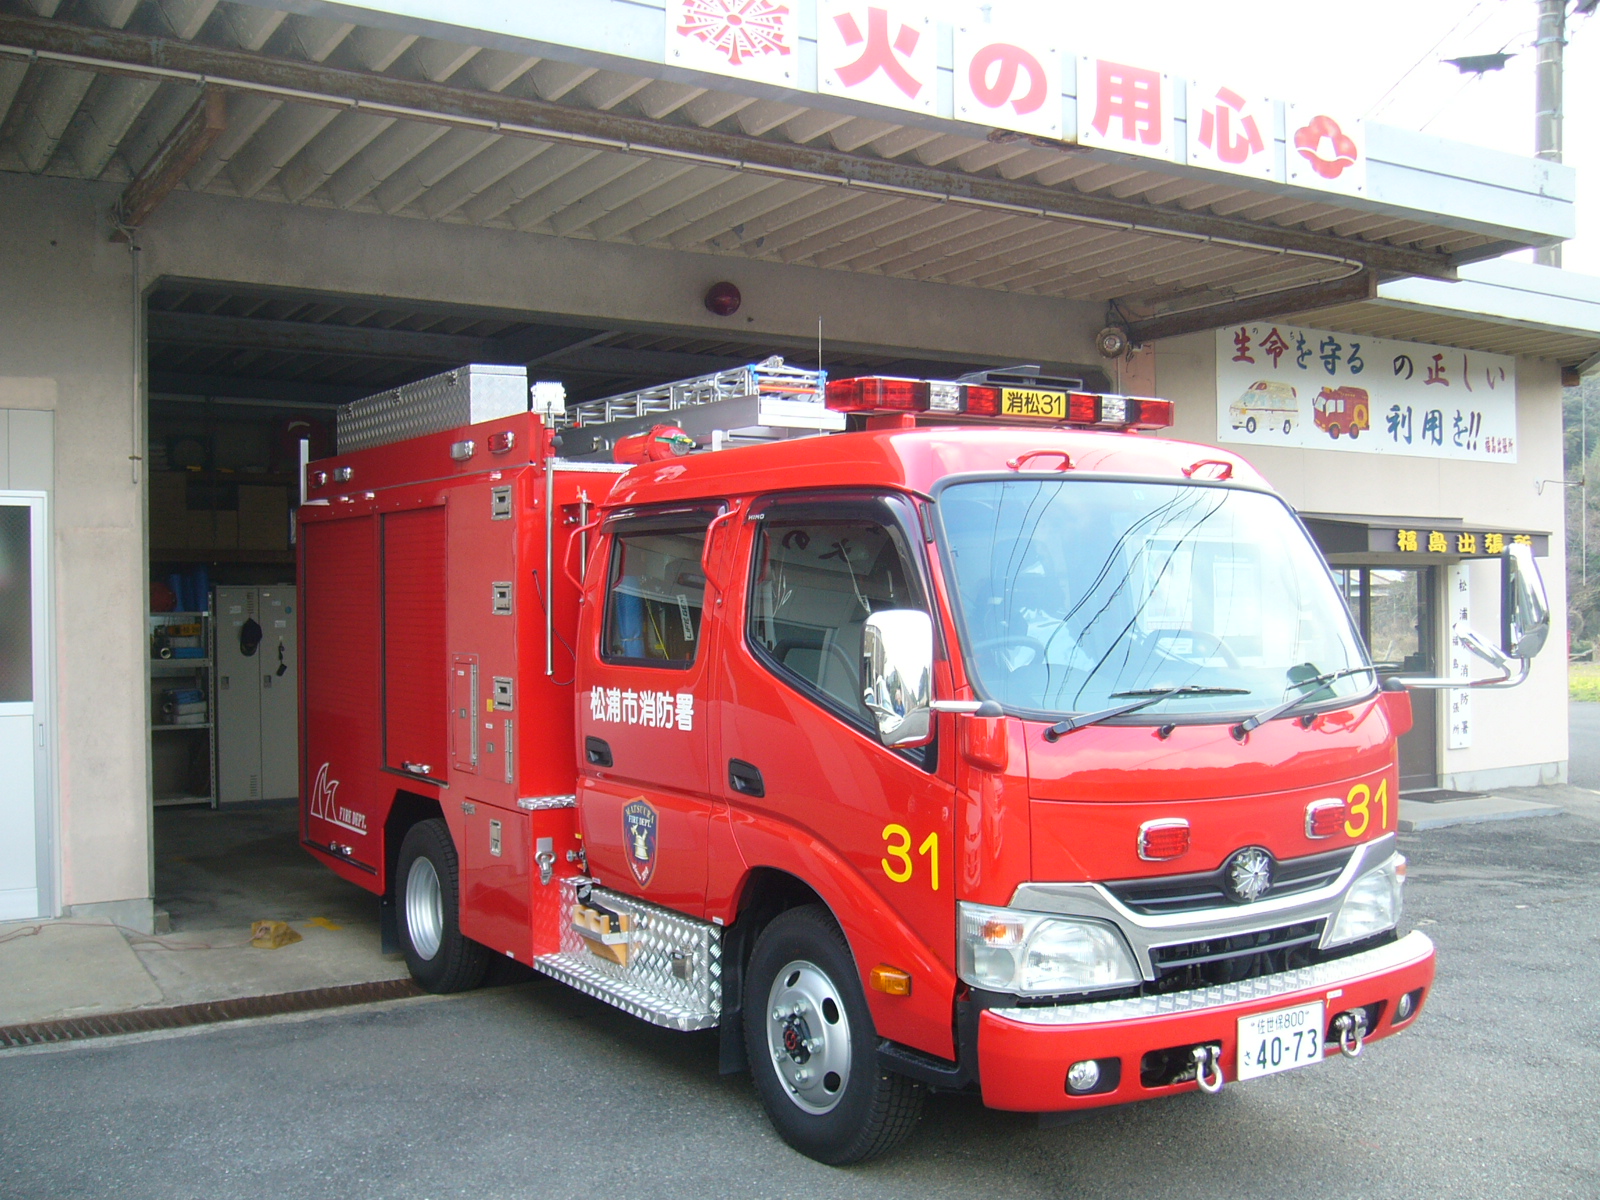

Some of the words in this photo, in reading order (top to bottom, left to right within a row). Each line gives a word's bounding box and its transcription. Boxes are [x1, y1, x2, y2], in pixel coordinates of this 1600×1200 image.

[834, 6, 1265, 164] 火の用心
[1232, 326, 1364, 376] 生命を守る
[1393, 353, 1505, 392] の正しい
[1007, 391, 1061, 415] 消松31
[1385, 404, 1481, 451] 利用を!!
[1452, 635, 1460, 735] 福島張所
[1458, 579, 1469, 734] 松浦消防署
[590, 685, 694, 731] 松浦市消防署
[339, 806, 352, 824] FIRE
[1344, 778, 1387, 838] 31
[881, 823, 939, 891] 31
[1257, 1028, 1317, 1069] 40-73
